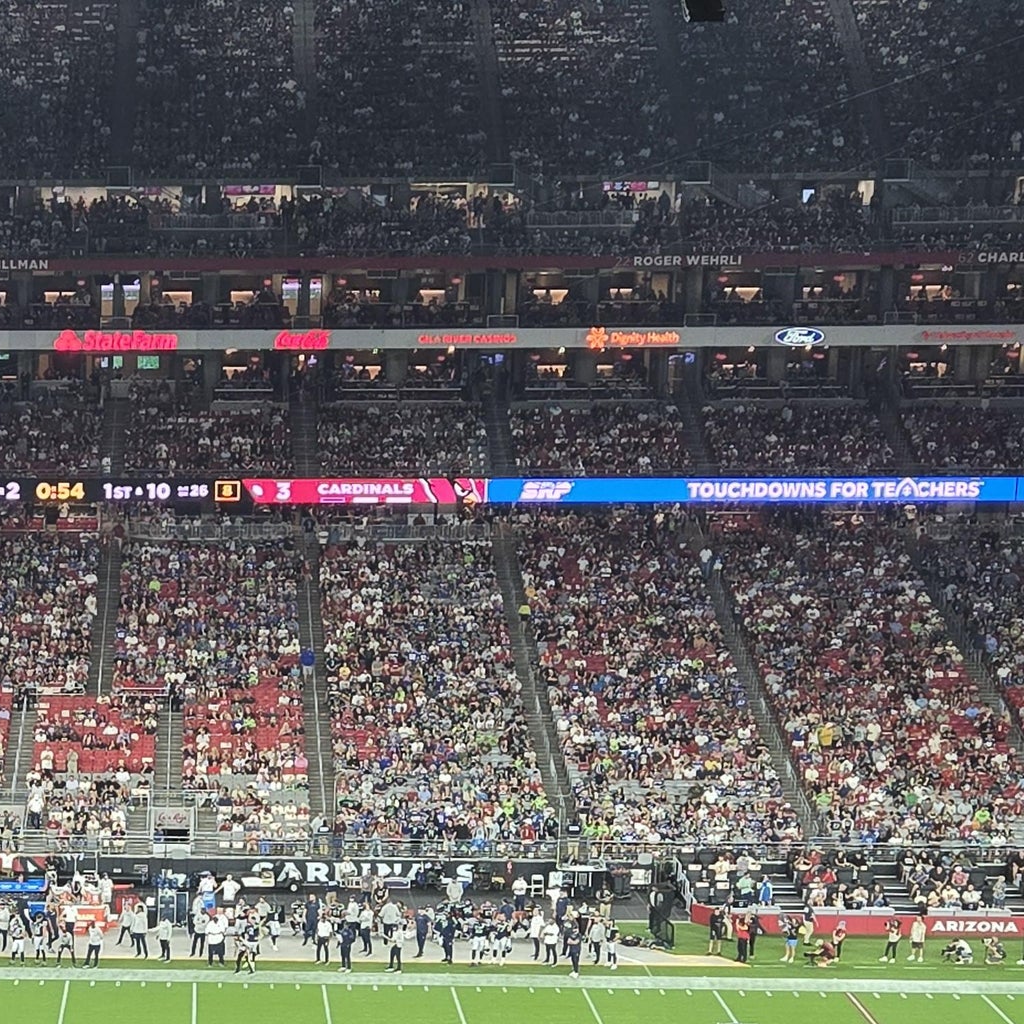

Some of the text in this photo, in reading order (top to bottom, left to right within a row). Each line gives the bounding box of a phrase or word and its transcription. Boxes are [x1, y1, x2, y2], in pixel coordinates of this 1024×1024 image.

[633, 256, 681, 266] ROGER
[686, 255, 742, 265] WEHRLI
[610, 331, 680, 346] Dignity Health
[783, 330, 816, 344] Ford
[5, 482, 20, 500] 2
[35, 482, 85, 500] 0:54
[103, 483, 133, 499] 1ST
[146, 483, 171, 499] 10
[189, 484, 209, 498] 26
[276, 482, 291, 500] 3
[317, 484, 414, 495] CARDINALS
[520, 482, 571, 500] SRP
[687, 477, 980, 498] TOUCHDOWNS FOR TEACHERS
[931, 920, 1019, 933] ARIZONA
